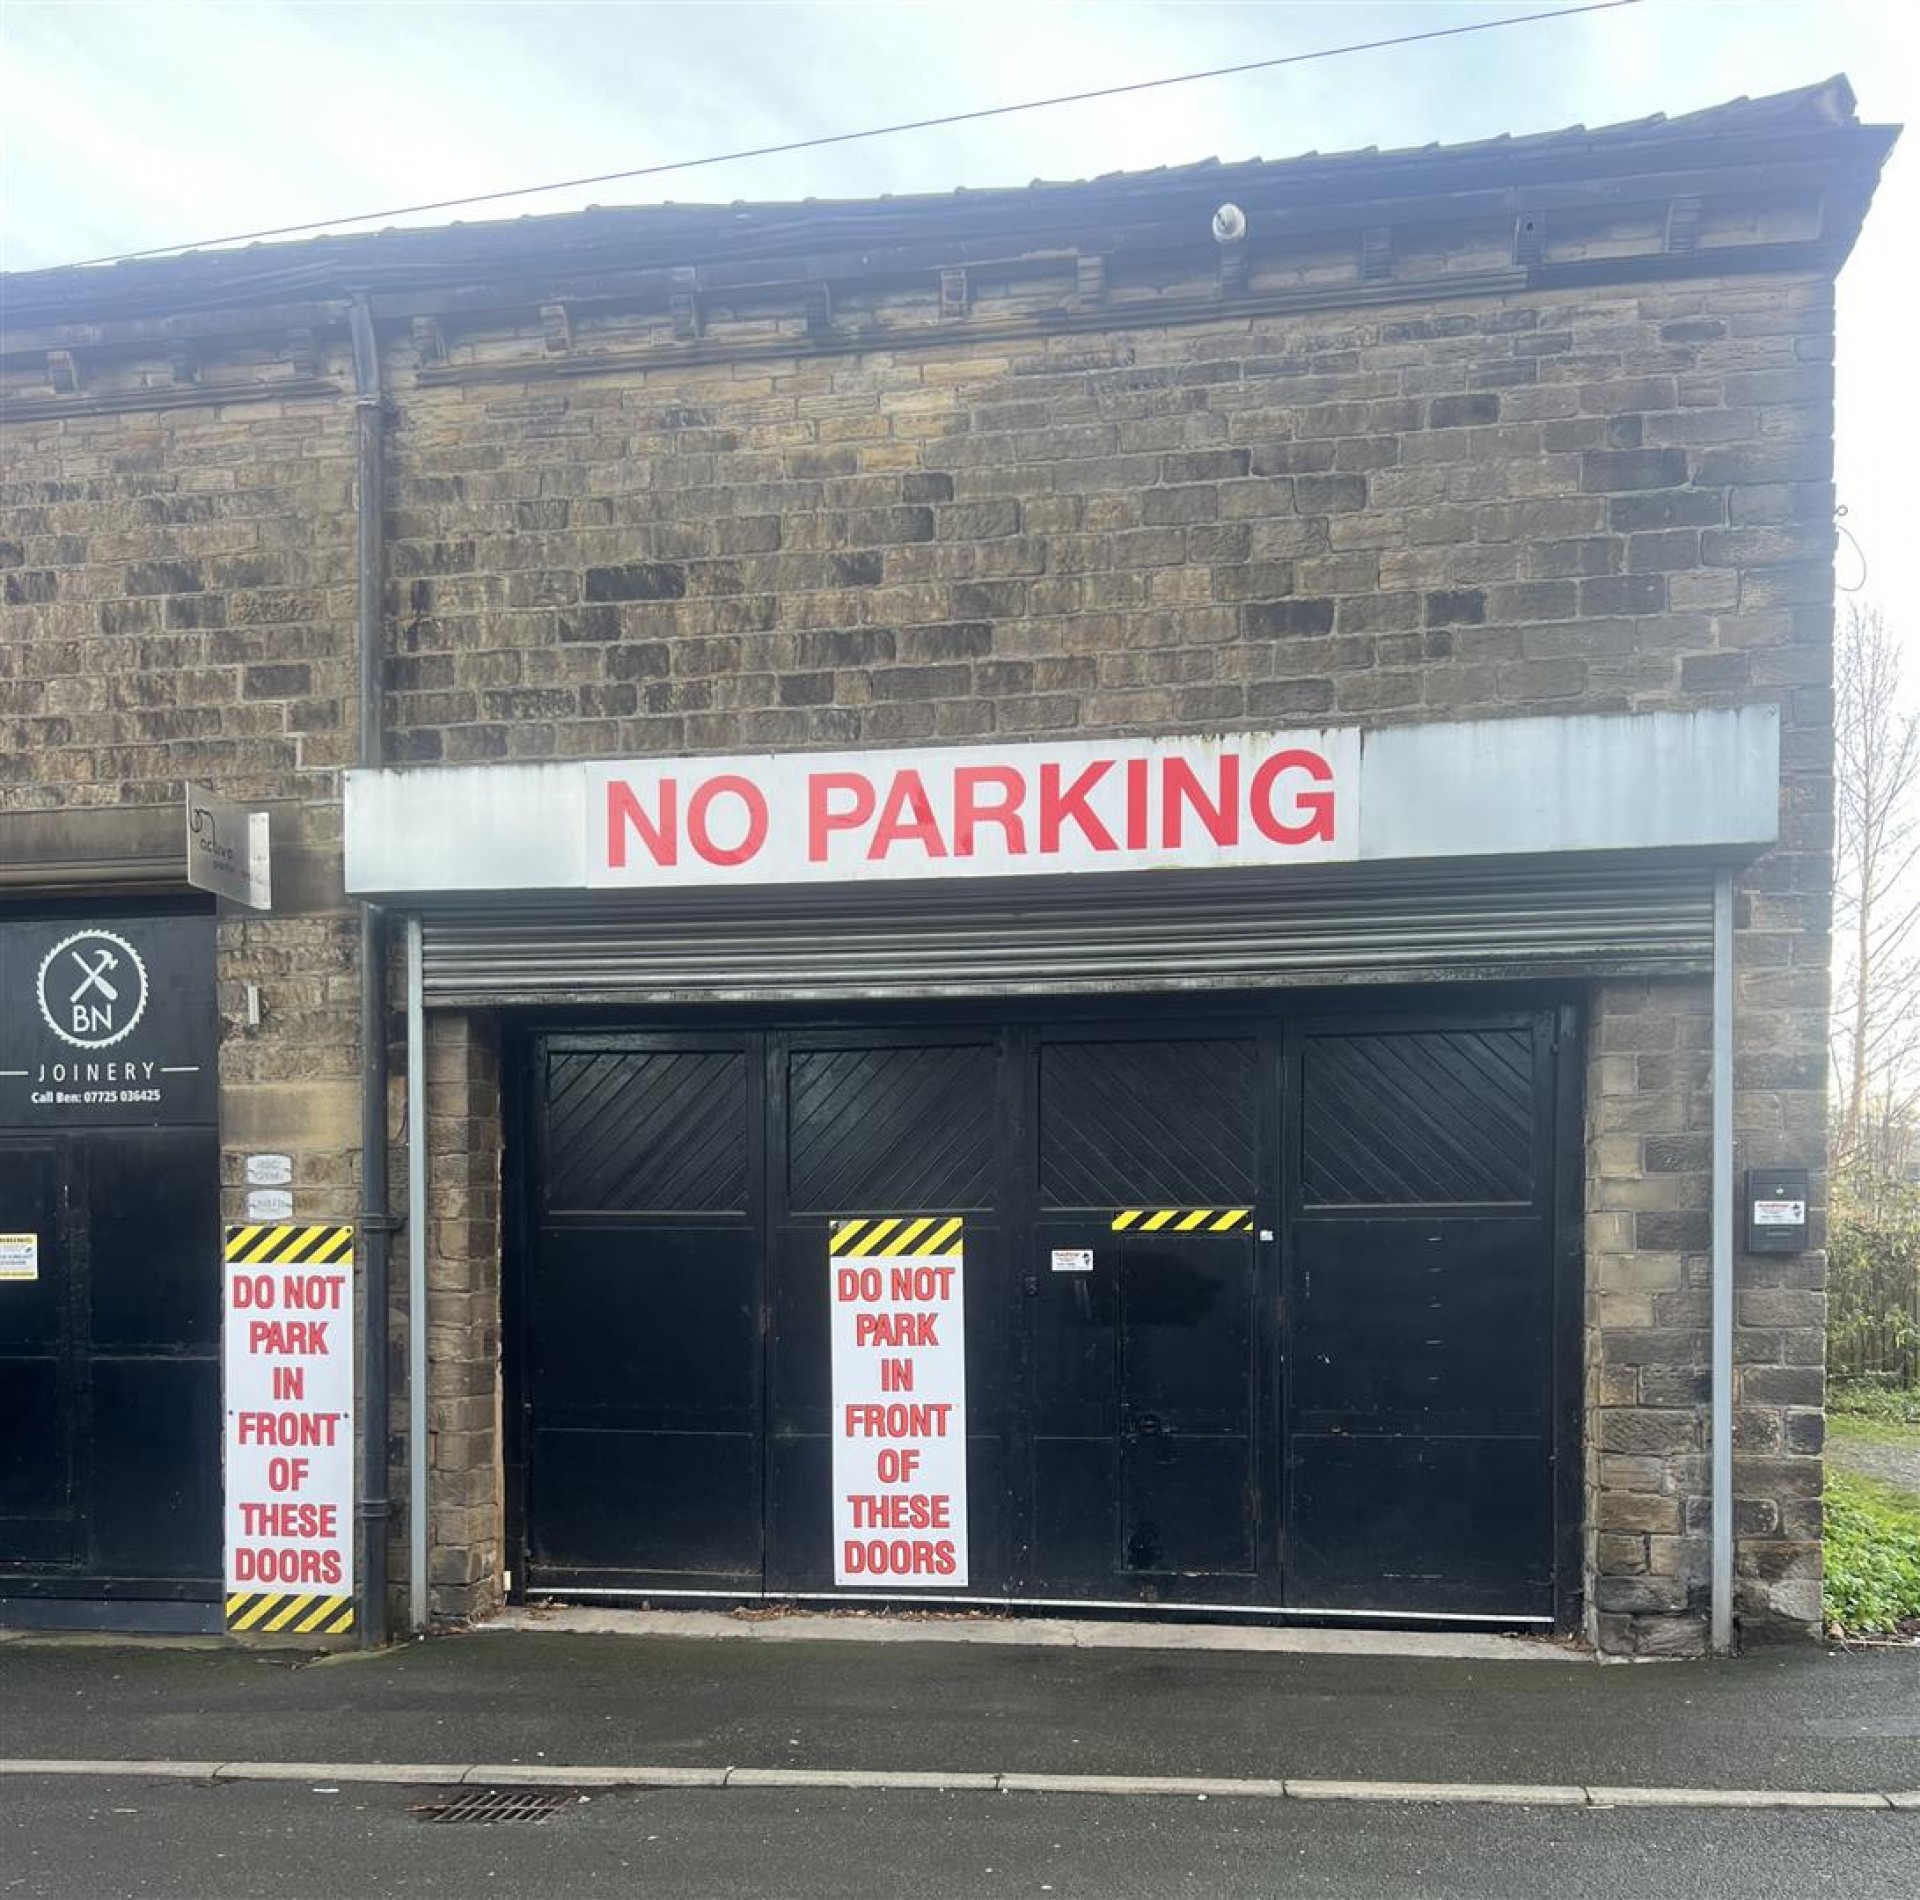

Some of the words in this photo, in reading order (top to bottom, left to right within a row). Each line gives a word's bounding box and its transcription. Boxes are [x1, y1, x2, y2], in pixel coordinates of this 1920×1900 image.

[606, 774, 769, 869] NO
[807, 747, 1337, 863] PARKING
[72, 1003, 112, 1032] BN
[37, 1061, 155, 1083] JOINERY
[31, 1091, 54, 1104] Call
[55, 1091, 82, 1104] Ben:
[83, 1090, 118, 1103] 07725
[119, 1088, 161, 1102] 036425
[232, 1274, 276, 1310] DO
[282, 1275, 346, 1309] NOT
[837, 1267, 882, 1302] DO
[889, 1266, 956, 1301] NOT
[249, 1320, 328, 1354] PARK
[855, 1312, 939, 1347] PARK
[272, 1368, 304, 1399] IN
[880, 1358, 914, 1392] IN
[238, 1412, 340, 1446] FRONT
[845, 1403, 952, 1438] FRONT
[268, 1457, 309, 1492] OF
[877, 1448, 920, 1483] OF
[240, 1503, 337, 1538] THESE
[847, 1493, 950, 1529] THESE
[234, 1547, 343, 1584] DOORS
[843, 1539, 957, 1575] DOORS
